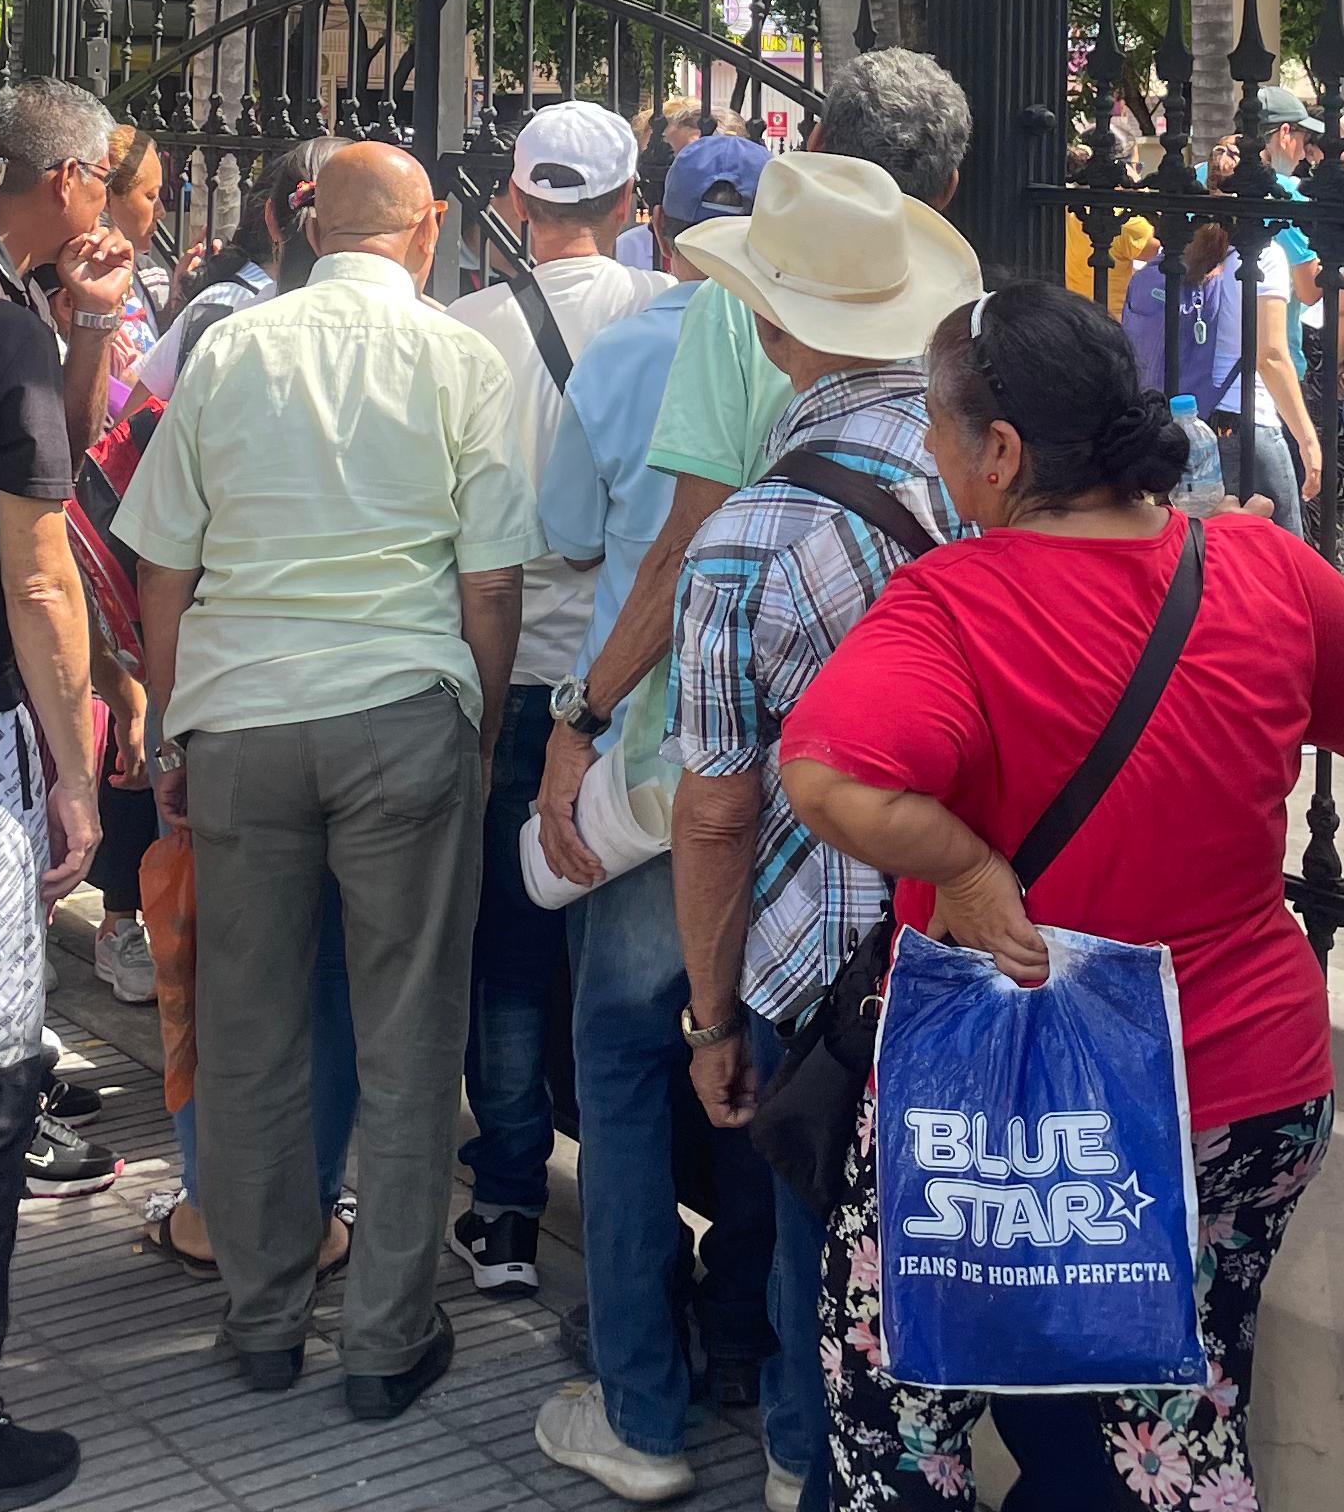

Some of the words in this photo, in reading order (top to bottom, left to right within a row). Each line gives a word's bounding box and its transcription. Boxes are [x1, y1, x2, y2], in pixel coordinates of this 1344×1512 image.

[904, 1108, 1119, 1178] BLUE
[903, 1177, 1127, 1249] STAR
[899, 1256, 957, 1278] JEANS
[961, 1261, 983, 1284] DE
[988, 1265, 1060, 1287] HORMA
[1064, 1262, 1171, 1285] PERFECTA
